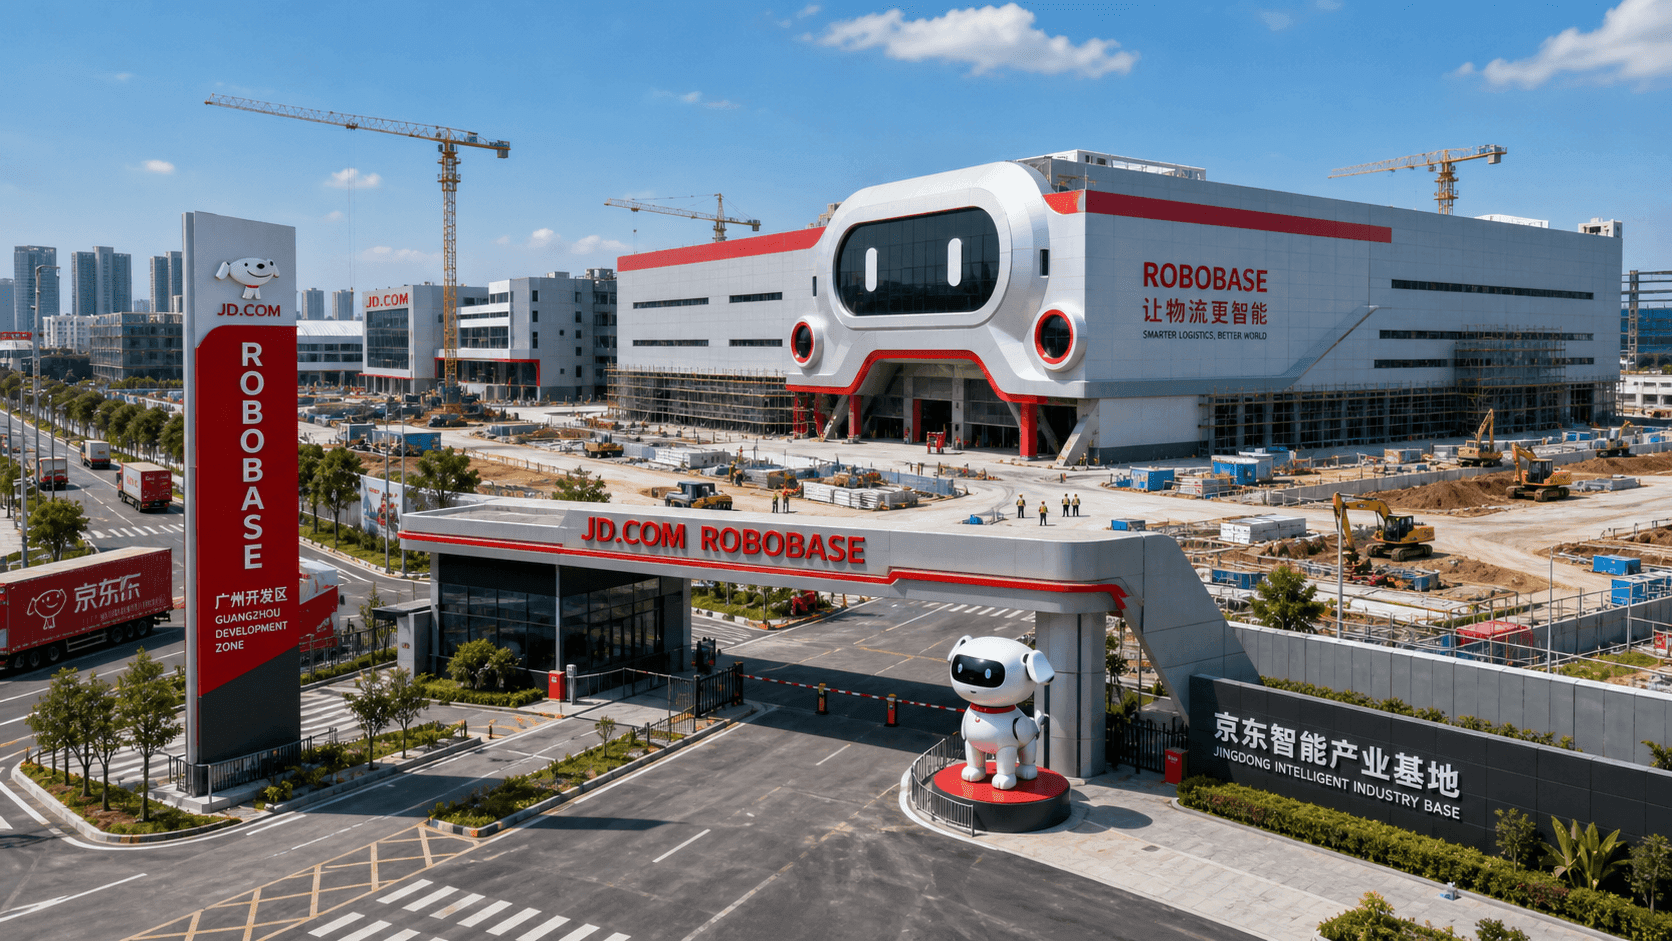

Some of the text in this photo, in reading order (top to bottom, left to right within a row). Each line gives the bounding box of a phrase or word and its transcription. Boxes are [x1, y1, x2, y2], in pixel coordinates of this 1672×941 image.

[1143, 261, 1268, 293] ROBOBASE
[217, 303, 281, 317] JD.COM
[366, 292, 408, 308] JD.COM
[1142, 297, 1268, 325] 让物流更智能
[1142, 330, 1268, 340] SMARTER LOGISTICS, BETTER WORLD
[240, 342, 265, 569] ROBOBASE
[581, 516, 866, 564] JD.COM ROBOBASE
[215, 586, 288, 610] 广州开发区
[215, 607, 280, 625] GUANGZHOU
[215, 620, 288, 639] DEVELOPMENT
[215, 640, 244, 653] ZONE
[1214, 711, 1460, 798] 京东智能产业基地
[1213, 746, 1460, 820] JINGDONG INTELLIGENT INDUSTRY BASE
